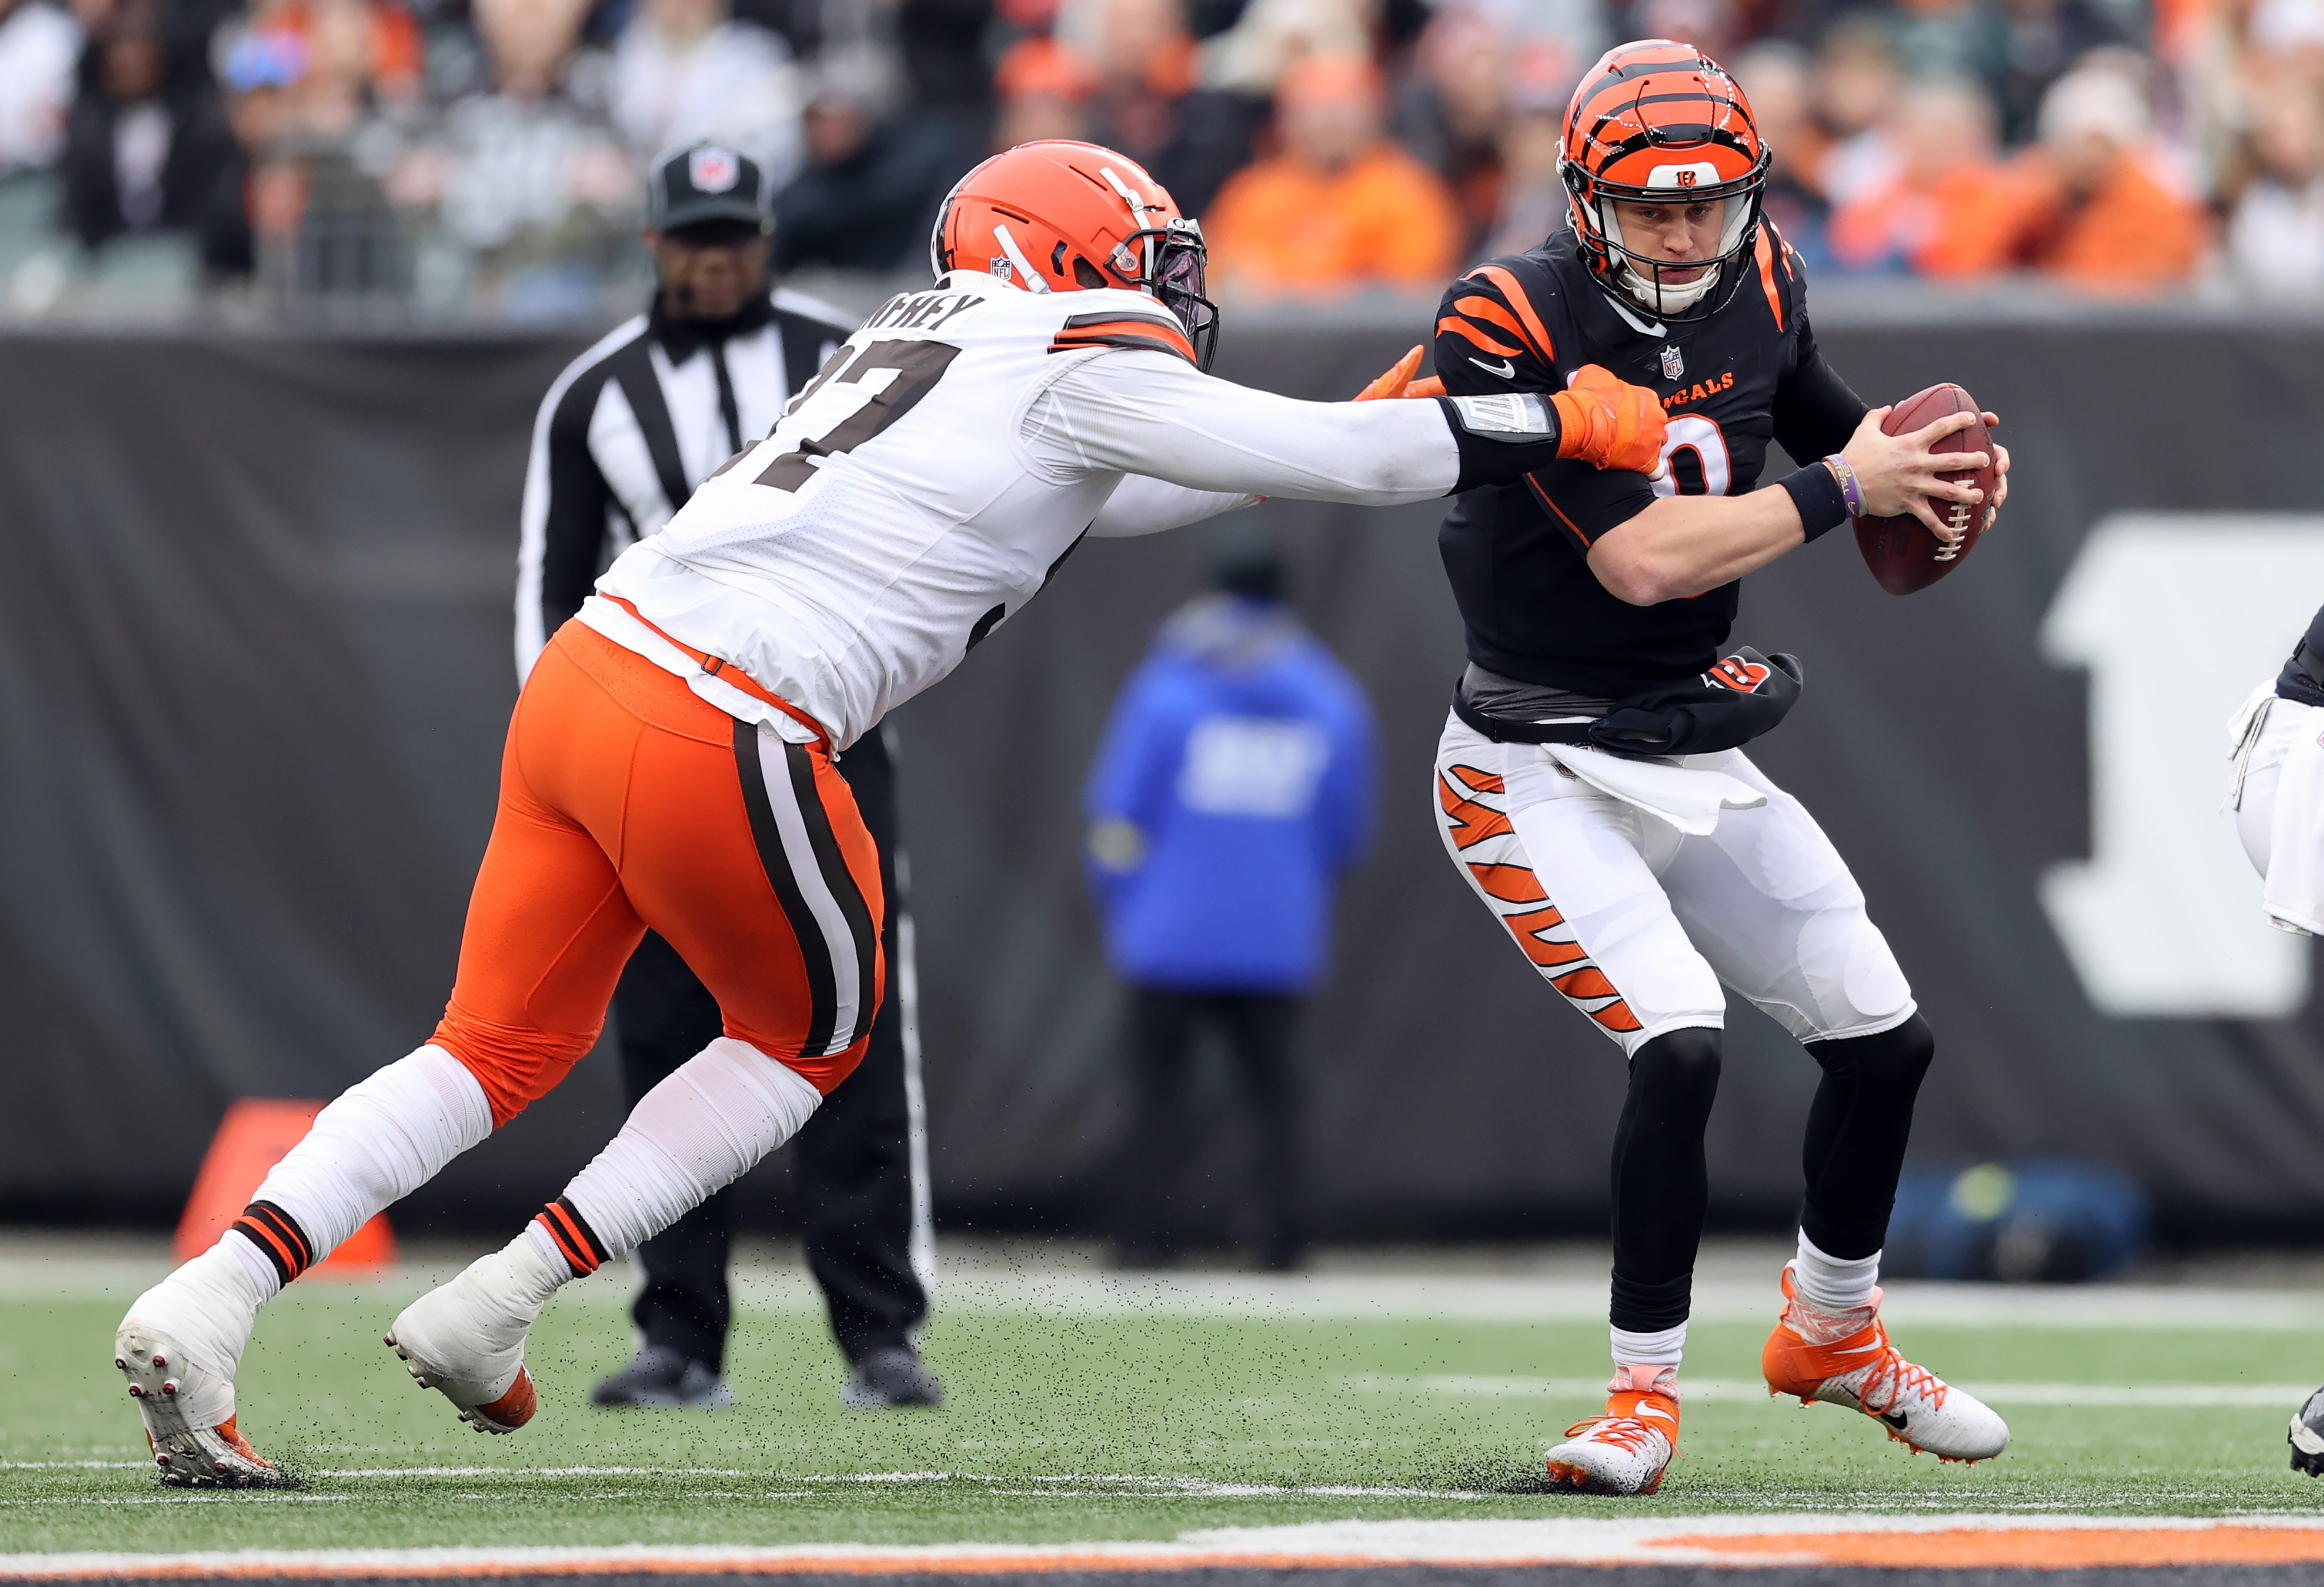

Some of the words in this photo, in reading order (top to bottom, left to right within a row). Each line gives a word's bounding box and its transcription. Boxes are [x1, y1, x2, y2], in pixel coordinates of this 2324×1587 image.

[993, 267, 1009, 278] NFL
[1665, 361, 1681, 375] NFL
[1663, 371, 1734, 409] NGALS
